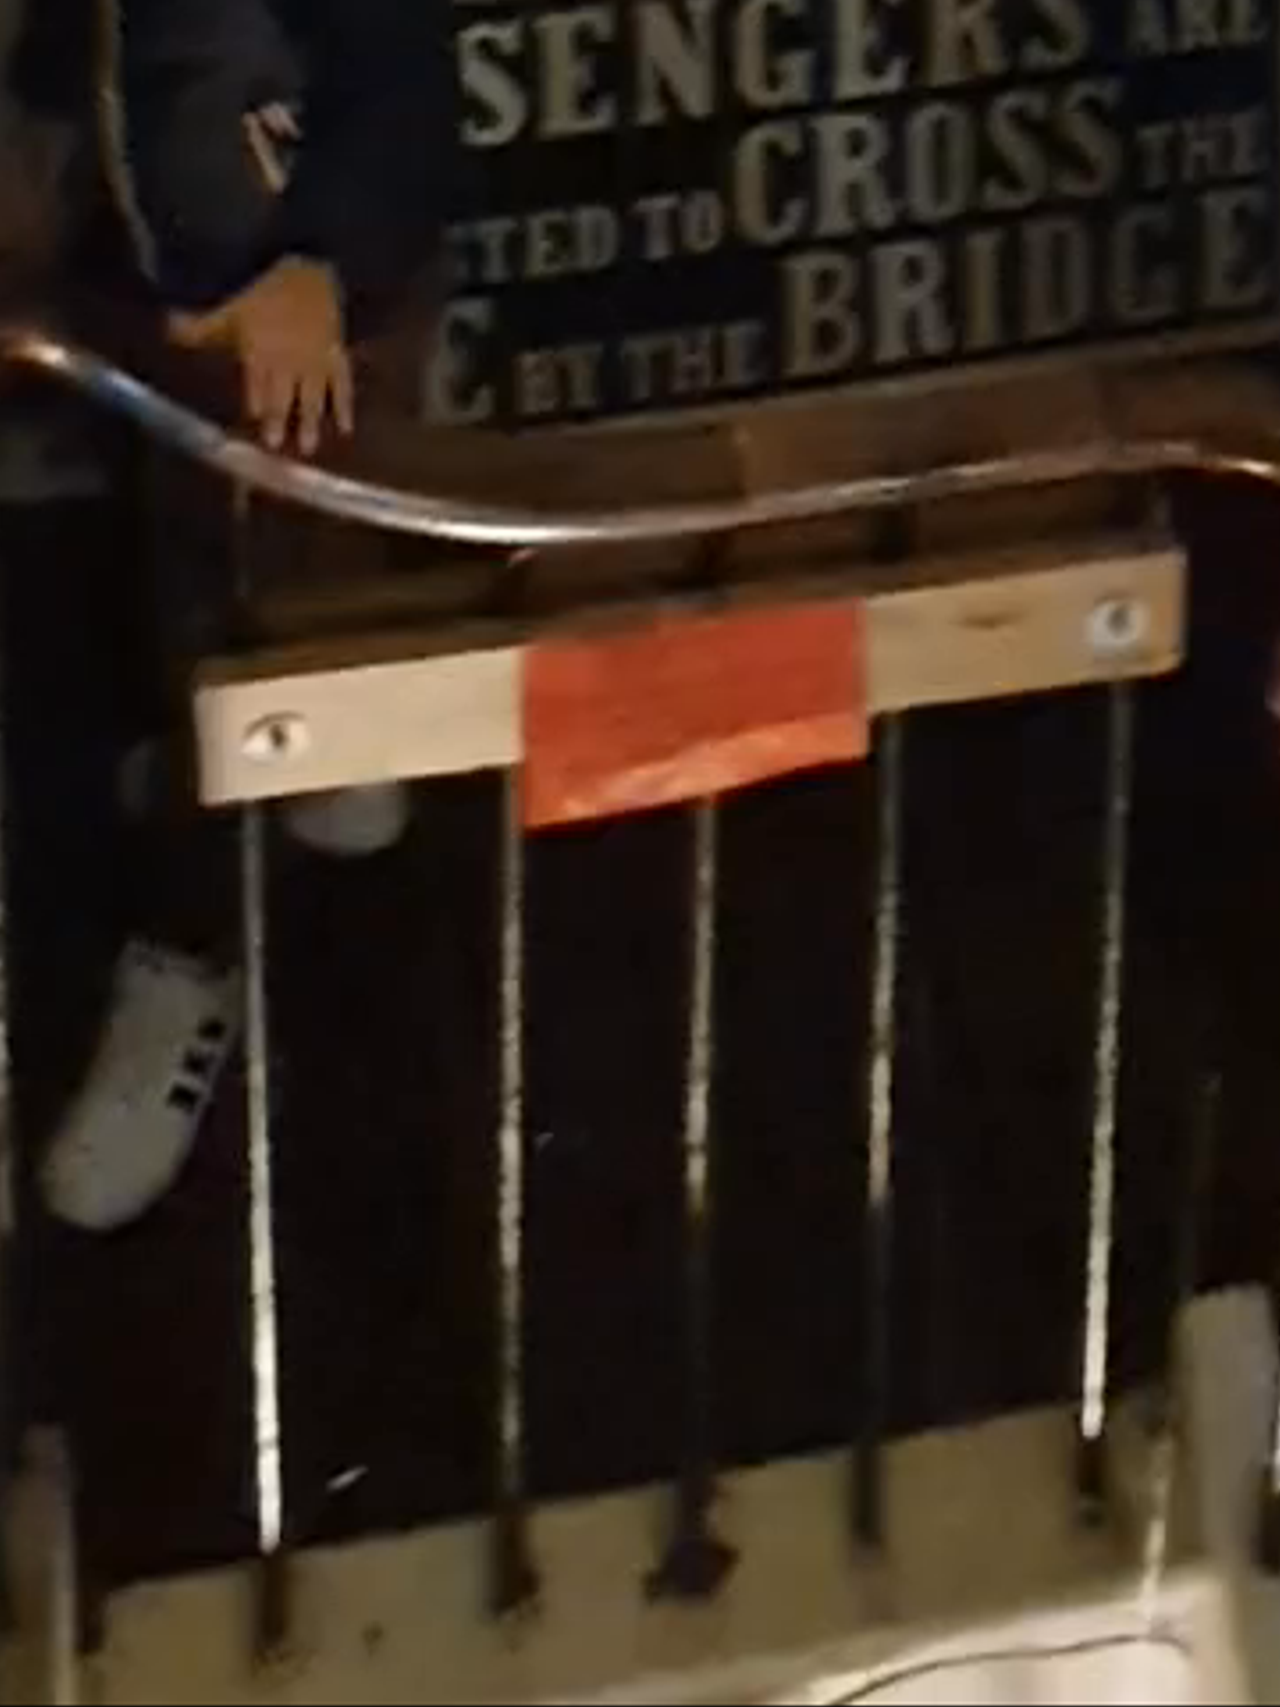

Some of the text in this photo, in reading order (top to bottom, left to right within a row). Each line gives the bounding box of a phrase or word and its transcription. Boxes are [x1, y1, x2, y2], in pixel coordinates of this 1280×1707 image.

[630, 186, 724, 262] TO
[733, 82, 1120, 248] CROSS
[1134, 110, 1270, 192] THE
[512, 342, 606, 418] BY
[620, 318, 766, 404] THE
[780, 186, 1274, 380] BRIDGE
